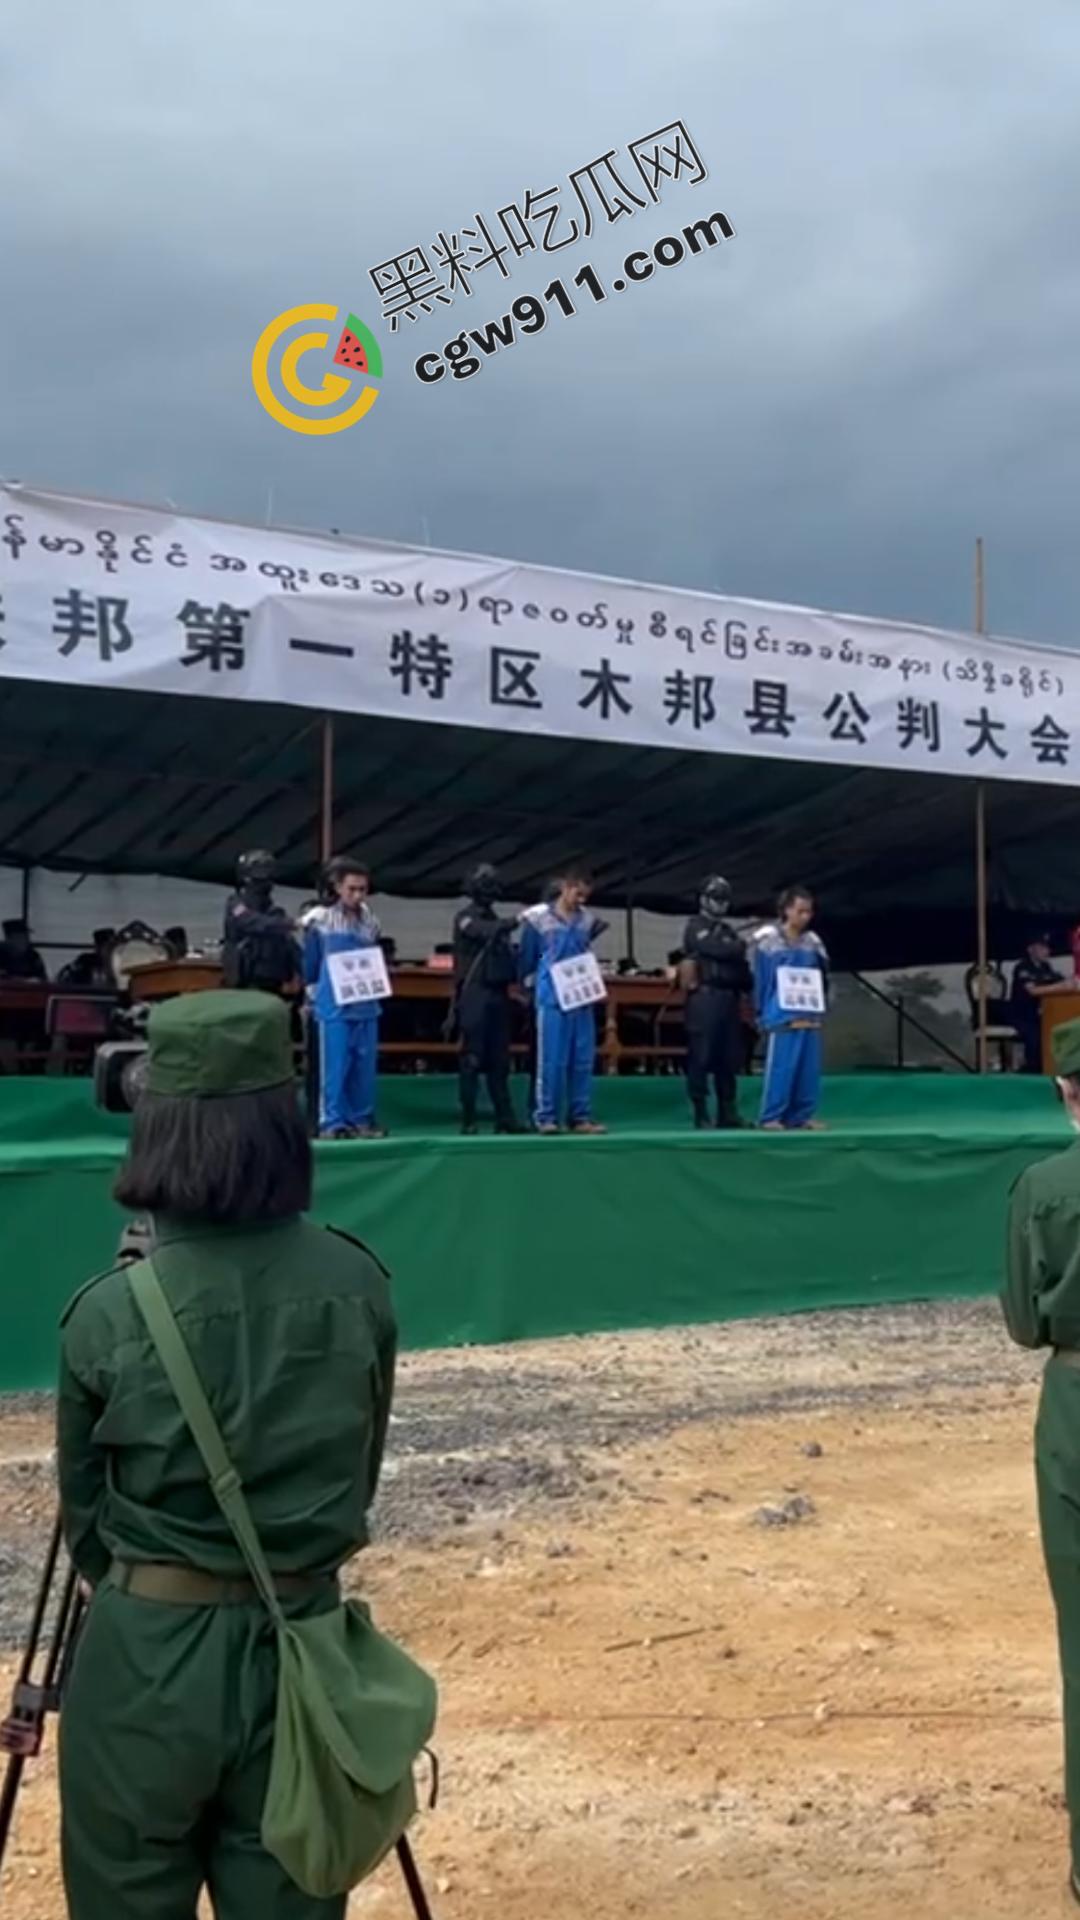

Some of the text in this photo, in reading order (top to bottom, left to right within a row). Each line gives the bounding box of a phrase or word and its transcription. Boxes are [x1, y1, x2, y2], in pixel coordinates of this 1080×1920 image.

[0, 588, 1070, 766] 邦第一特区木邦县公判大会
